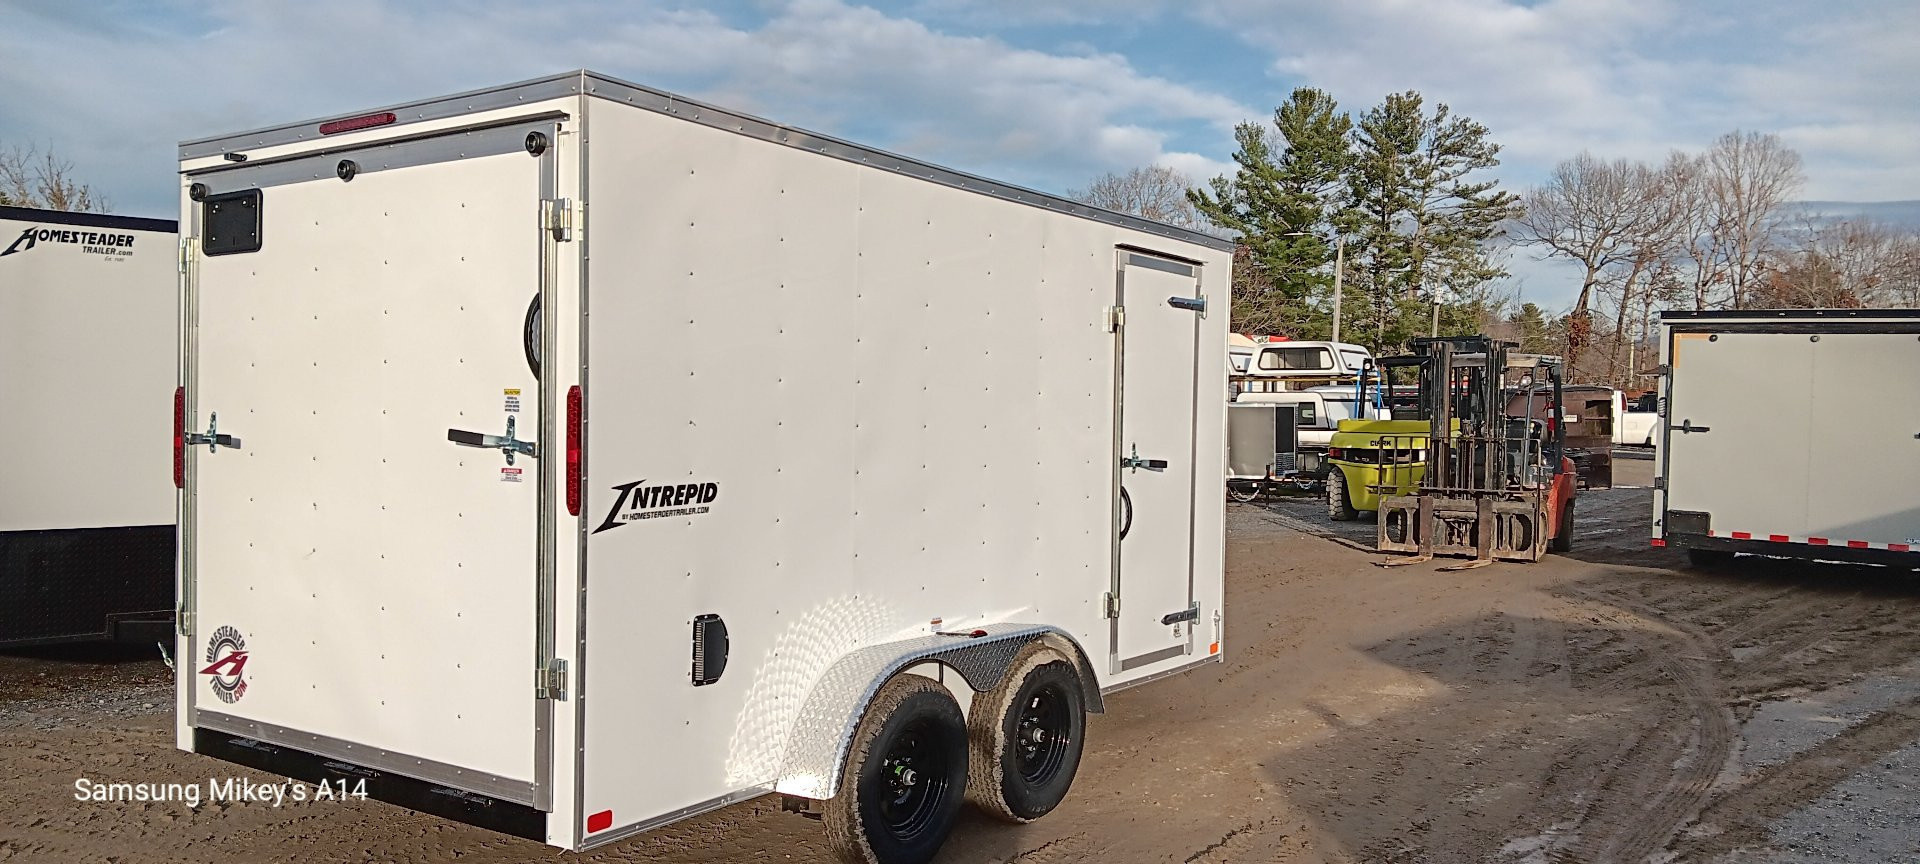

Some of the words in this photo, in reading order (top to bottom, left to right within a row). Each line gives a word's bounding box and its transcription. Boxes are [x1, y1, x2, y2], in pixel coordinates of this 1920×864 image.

[0, 226, 135, 256] HOMESTEADER
[591, 479, 718, 535] INTREPID
[629, 506, 710, 521] HOMESTEADERTRAILER.COM
[206, 625, 246, 663] HOMESTEADER
[209, 677, 248, 705] TRAILER.COM
